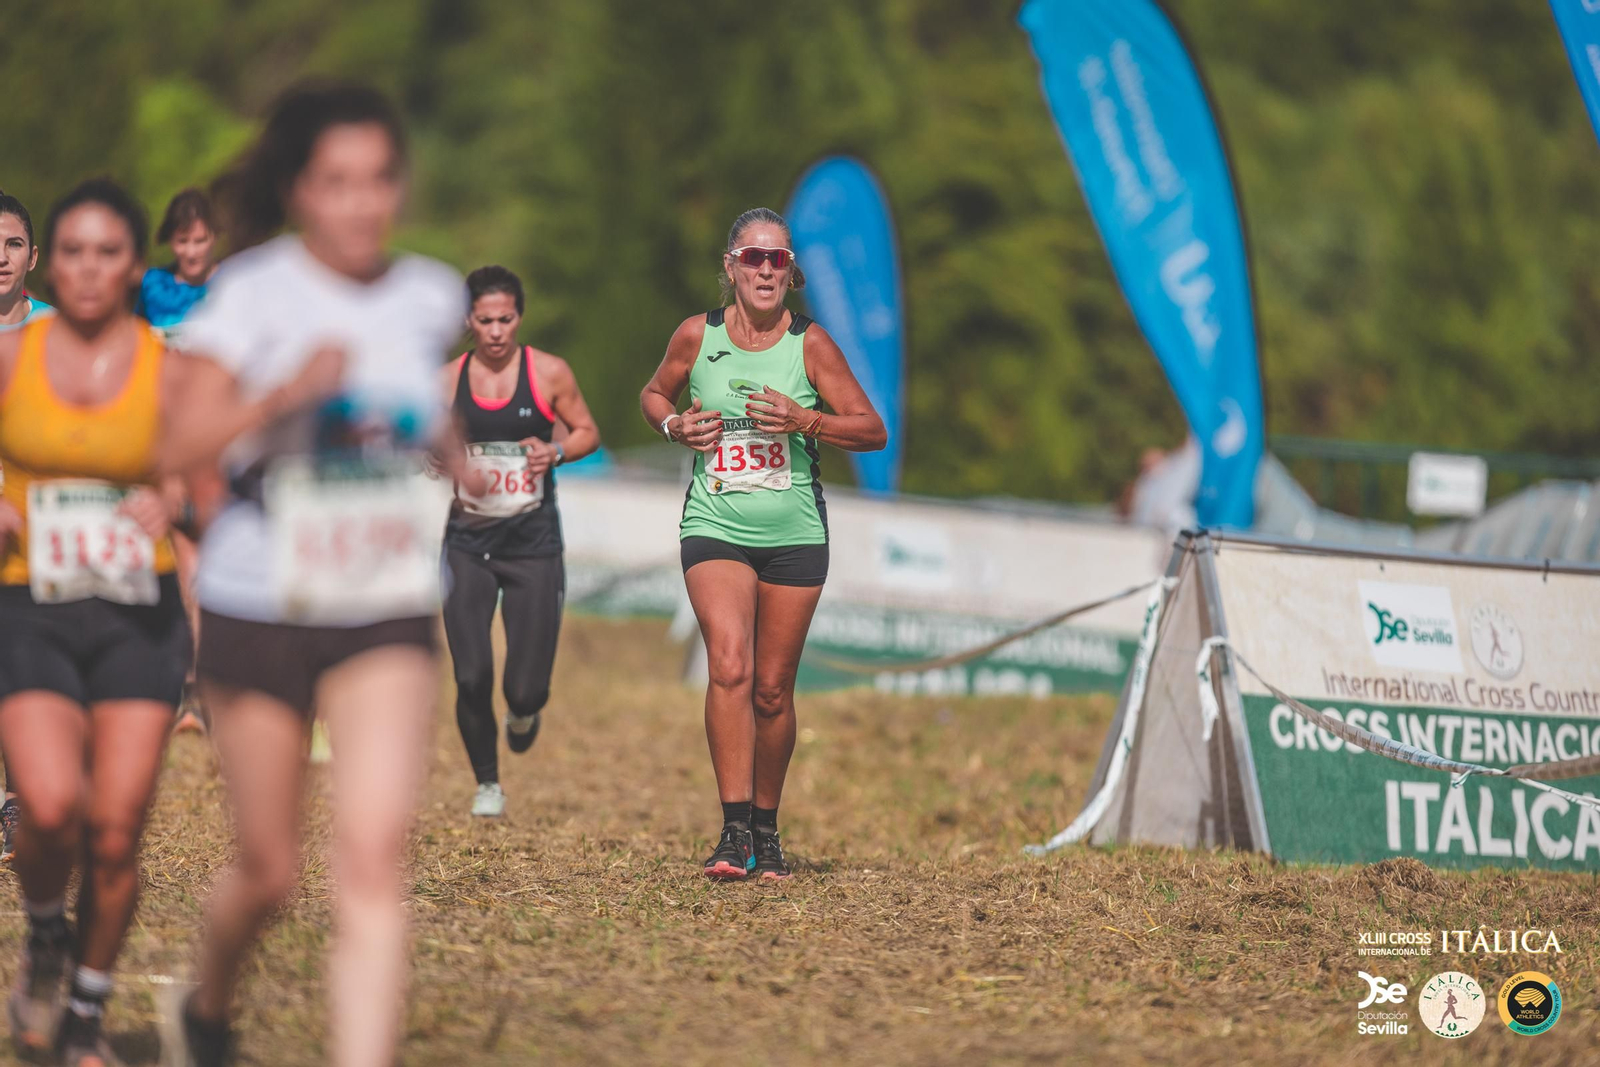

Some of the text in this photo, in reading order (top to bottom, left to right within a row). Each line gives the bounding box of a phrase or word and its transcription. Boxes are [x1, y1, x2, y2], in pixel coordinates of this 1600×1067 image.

[723, 419, 762, 430] ITÁLIC
[714, 442, 786, 472] 1358
[487, 469, 537, 495] 268
[1413, 628, 1453, 645] Sevilla
[1322, 666, 1460, 703] International
[1464, 678, 1526, 709] Cross
[1269, 703, 1392, 754] CROSS
